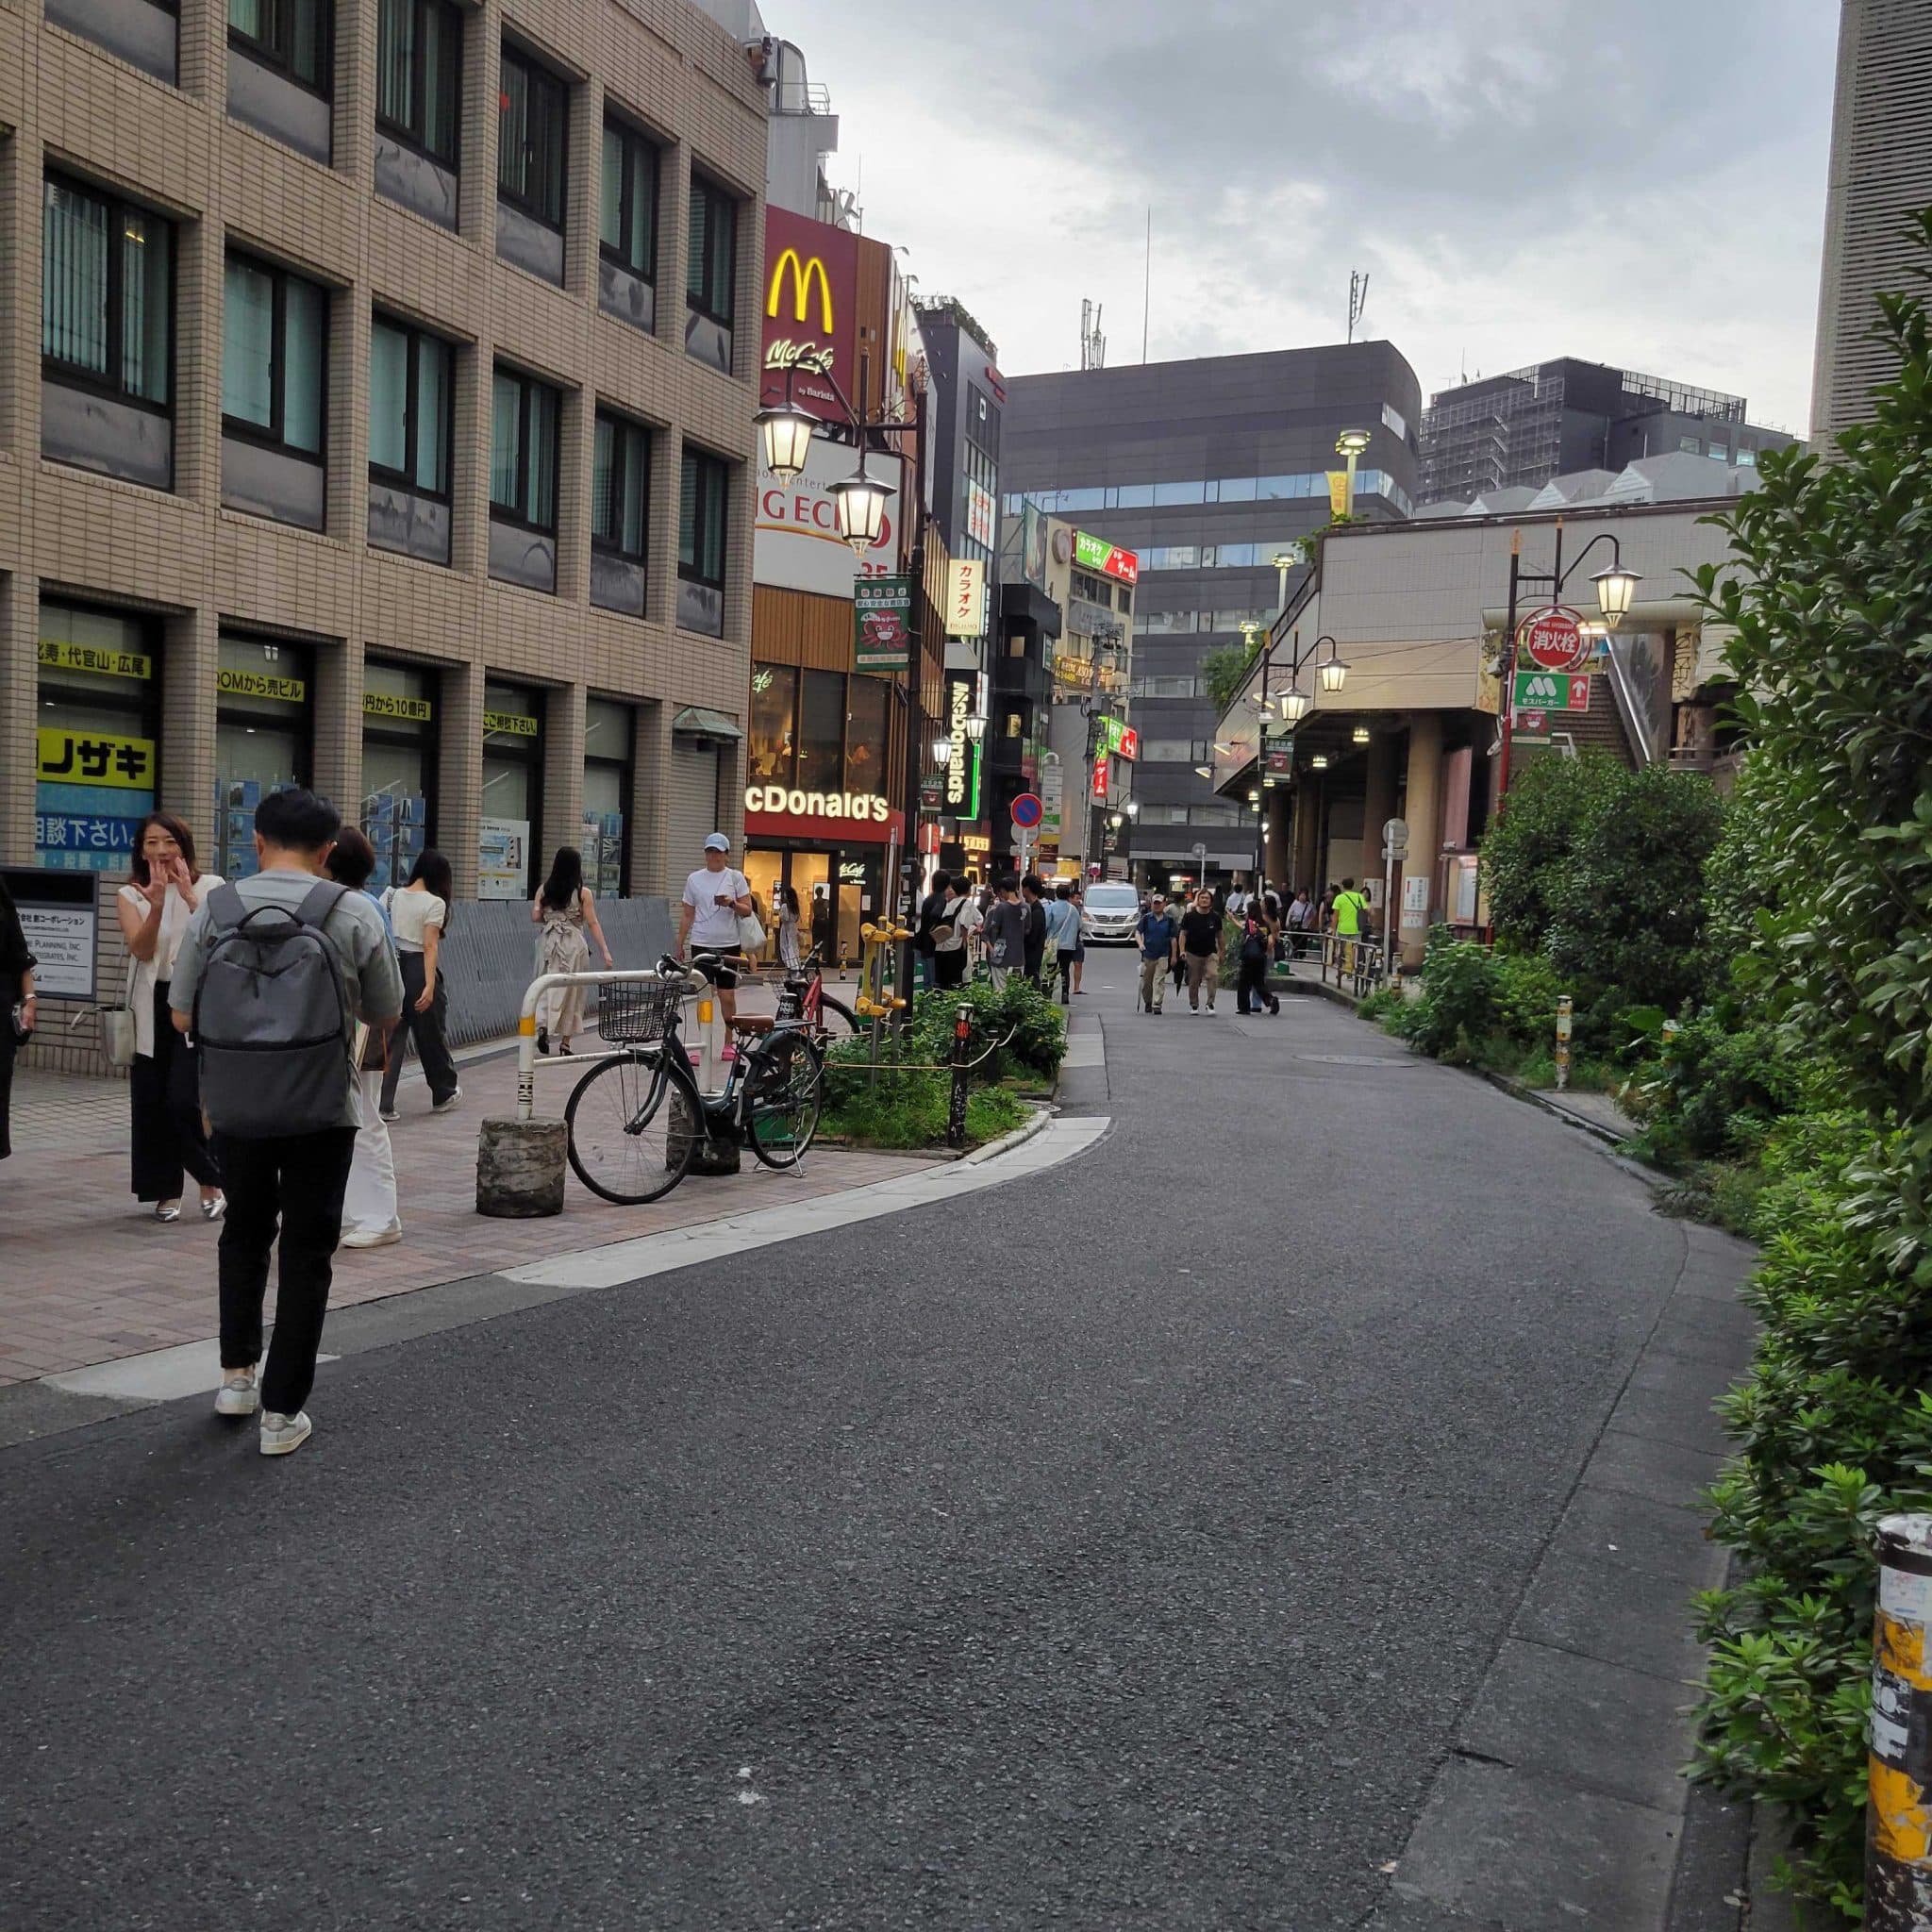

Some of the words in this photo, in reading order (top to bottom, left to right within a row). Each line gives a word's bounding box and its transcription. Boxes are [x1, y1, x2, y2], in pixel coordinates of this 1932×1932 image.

[958, 565, 973, 619] カラオケ
[1532, 629, 1577, 654] 消火栓
[1522, 697, 1559, 707] モスバーガー
[947, 681, 970, 804] McDonald's
[745, 786, 890, 823] cDonald's
